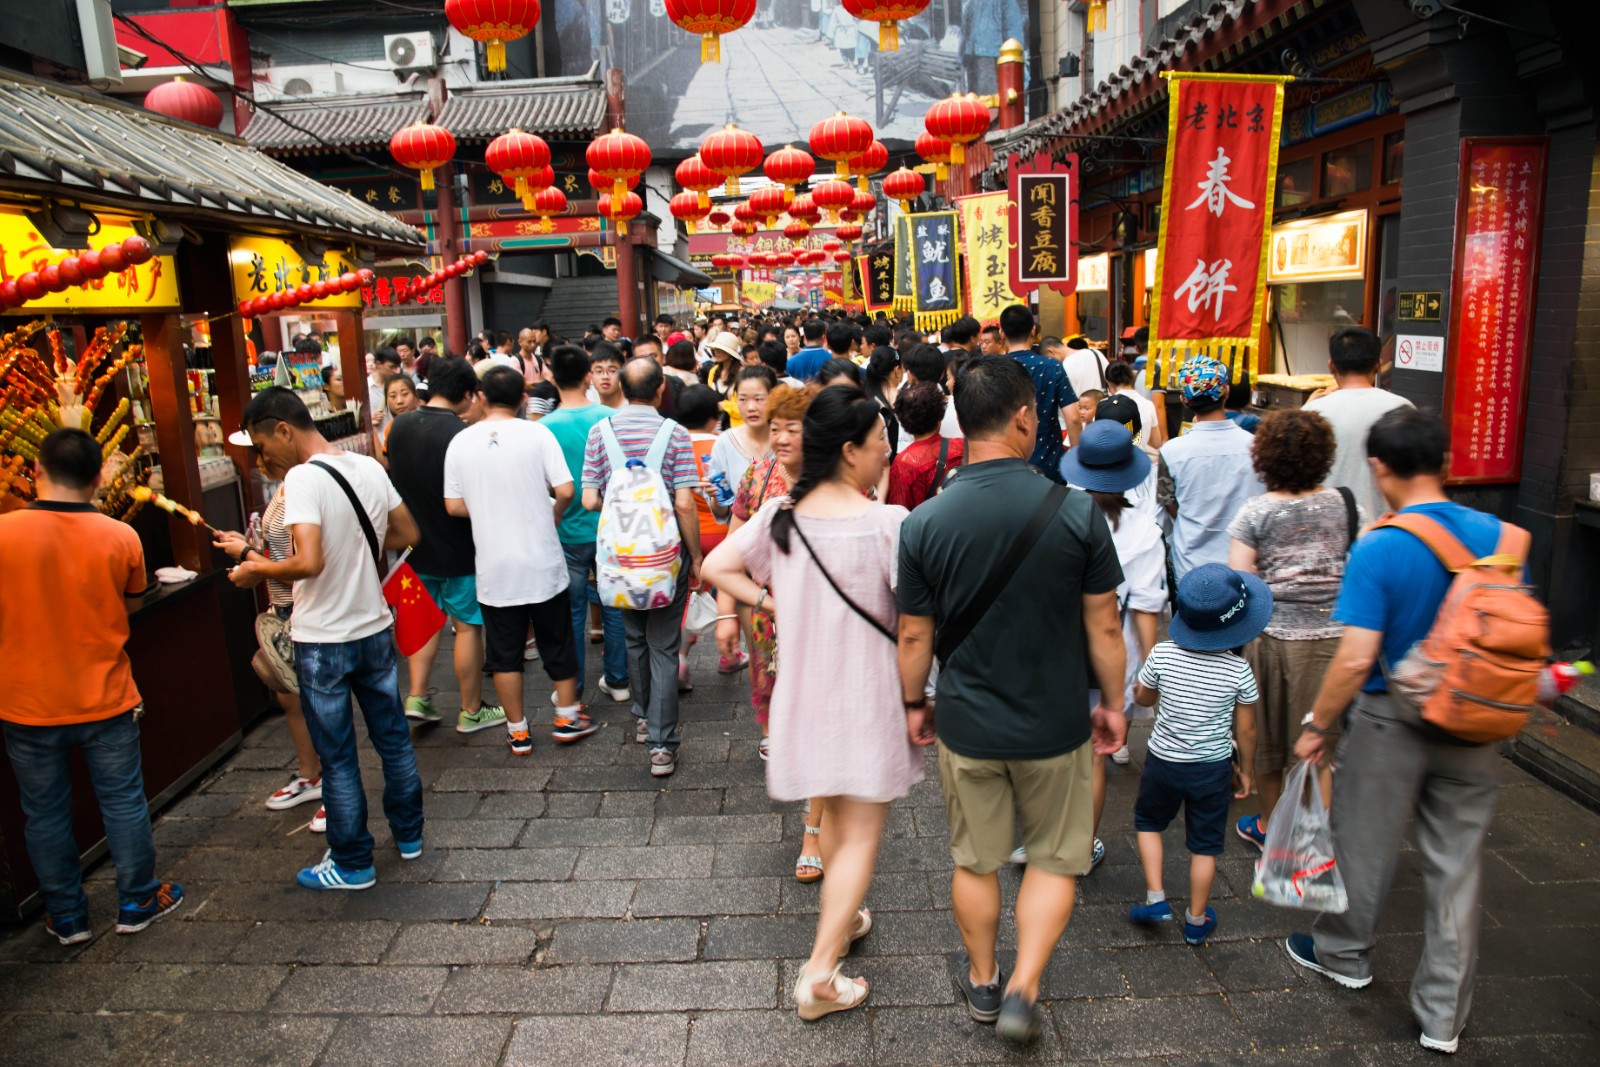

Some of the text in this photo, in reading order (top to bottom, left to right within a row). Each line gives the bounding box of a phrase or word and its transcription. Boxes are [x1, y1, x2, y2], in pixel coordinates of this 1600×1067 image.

[1185, 100, 1265, 133] 老北京
[1513, 161, 1532, 251] 土耳其烤肉
[976, 224, 1015, 309] 烤玉米
